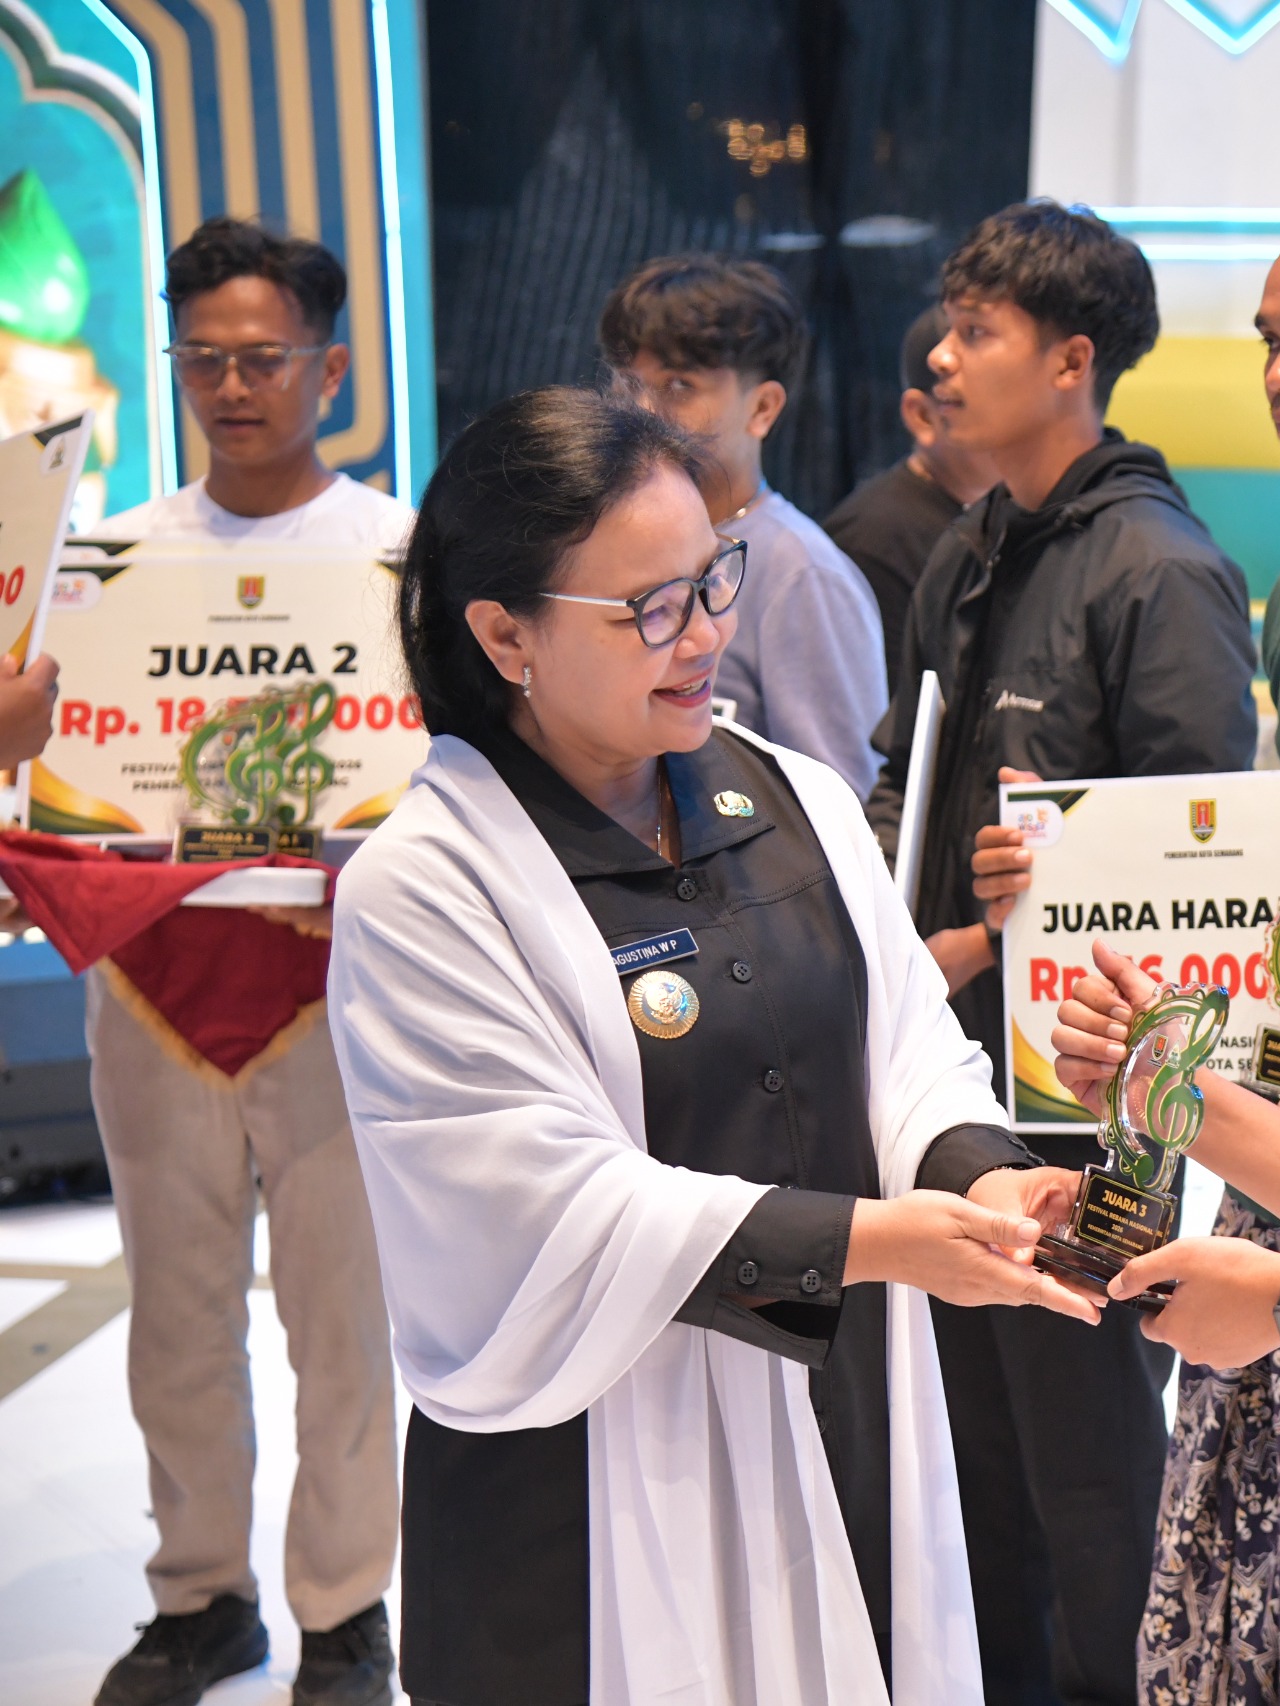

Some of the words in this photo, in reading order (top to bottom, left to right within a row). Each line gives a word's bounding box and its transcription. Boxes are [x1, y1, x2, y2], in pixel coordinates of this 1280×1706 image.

[148, 645, 315, 677] JUARA
[333, 644, 358, 673] 2
[60, 698, 140, 744] Rp.
[1042, 902, 1159, 933] JUARA
[658, 941, 669, 953] W
[670, 939, 677, 950] P
[1205, 1058, 1233, 1071] OTA
[1102, 1189, 1138, 1215] JUARA
[1139, 1204, 1148, 1218] 3
[1087, 1203, 1109, 1218] FESTIVAL
[1109, 1212, 1129, 1226] REBANA
[1129, 1220, 1154, 1236] NASIONAL
